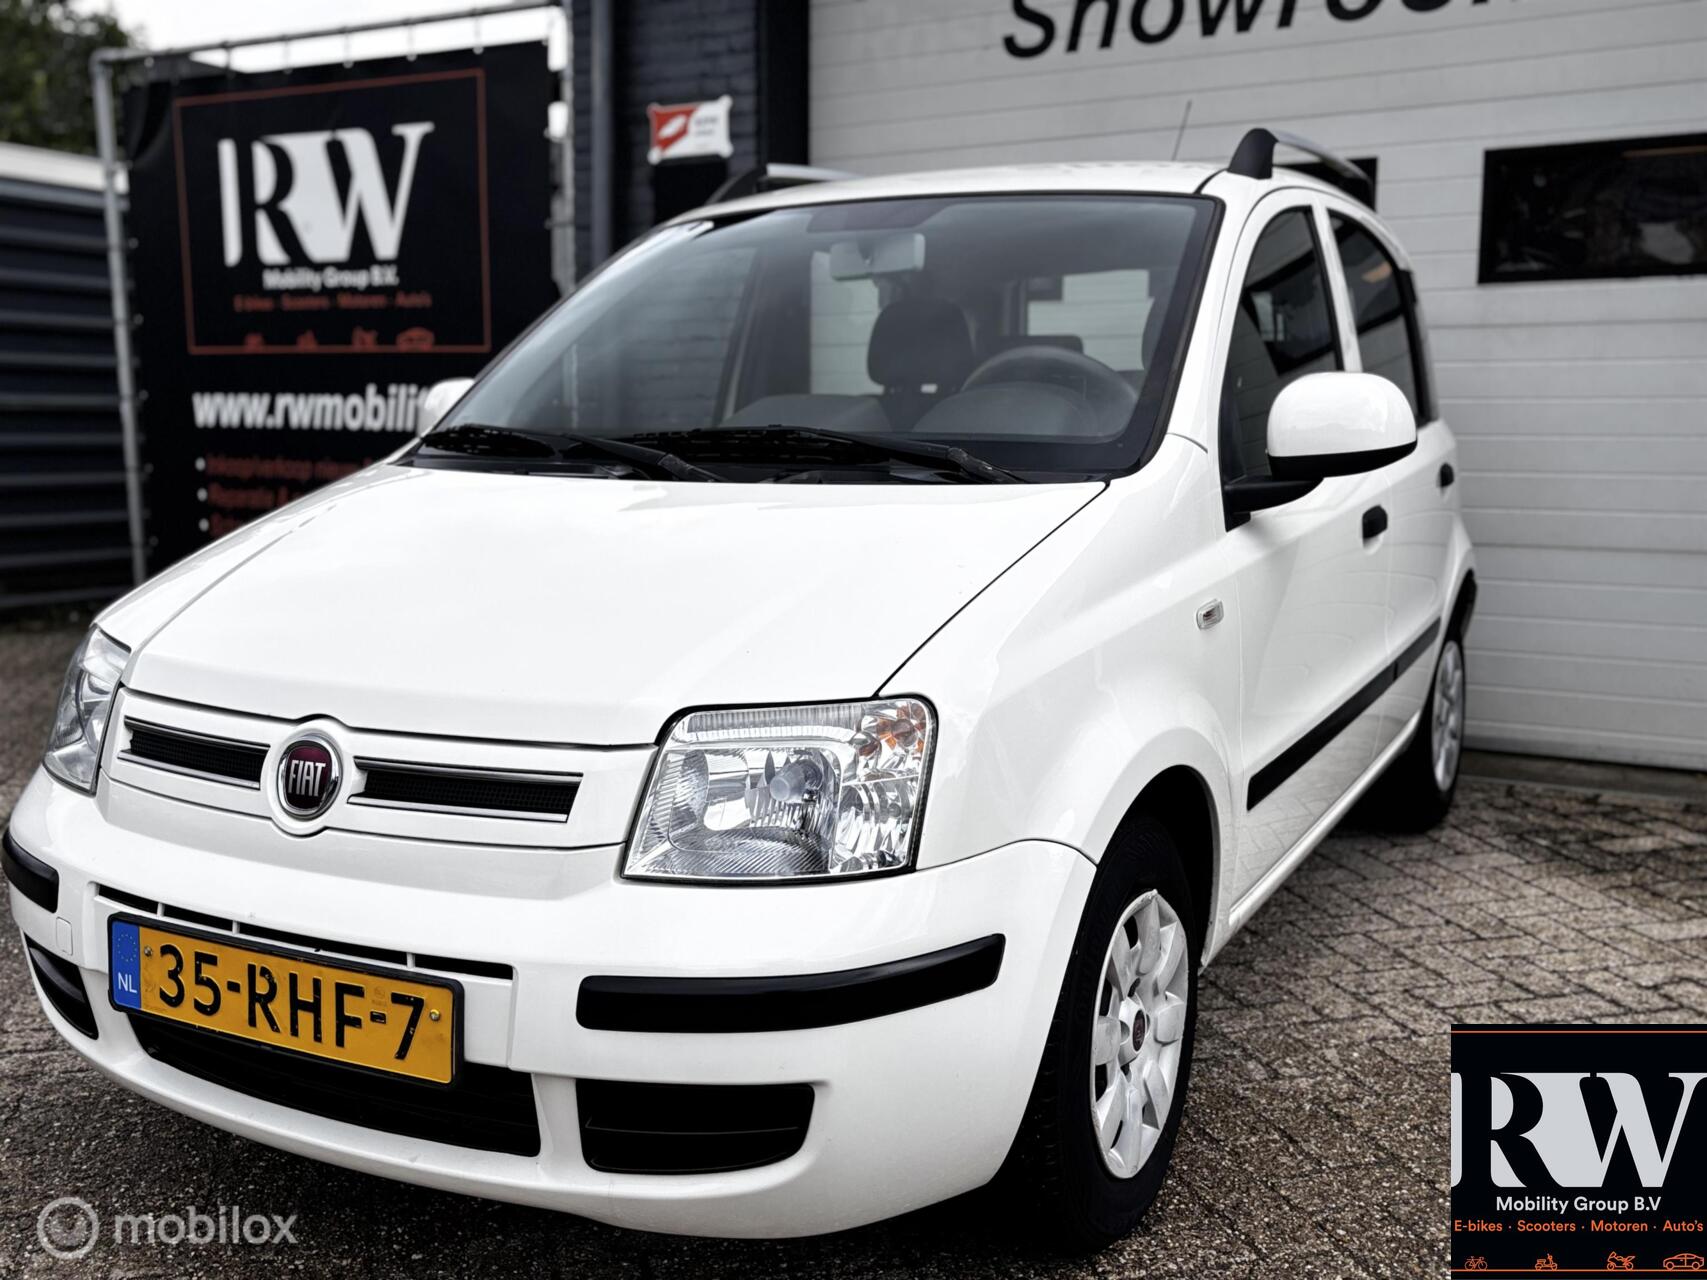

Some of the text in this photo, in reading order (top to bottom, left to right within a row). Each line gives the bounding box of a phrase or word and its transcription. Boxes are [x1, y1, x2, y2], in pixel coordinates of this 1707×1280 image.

[1003, 0, 1515, 58] Showr
[218, 121, 435, 267] RW
[287, 759, 327, 797] FIAT
[117, 971, 138, 995] NL
[159, 943, 425, 1061] 35-RHF-7
